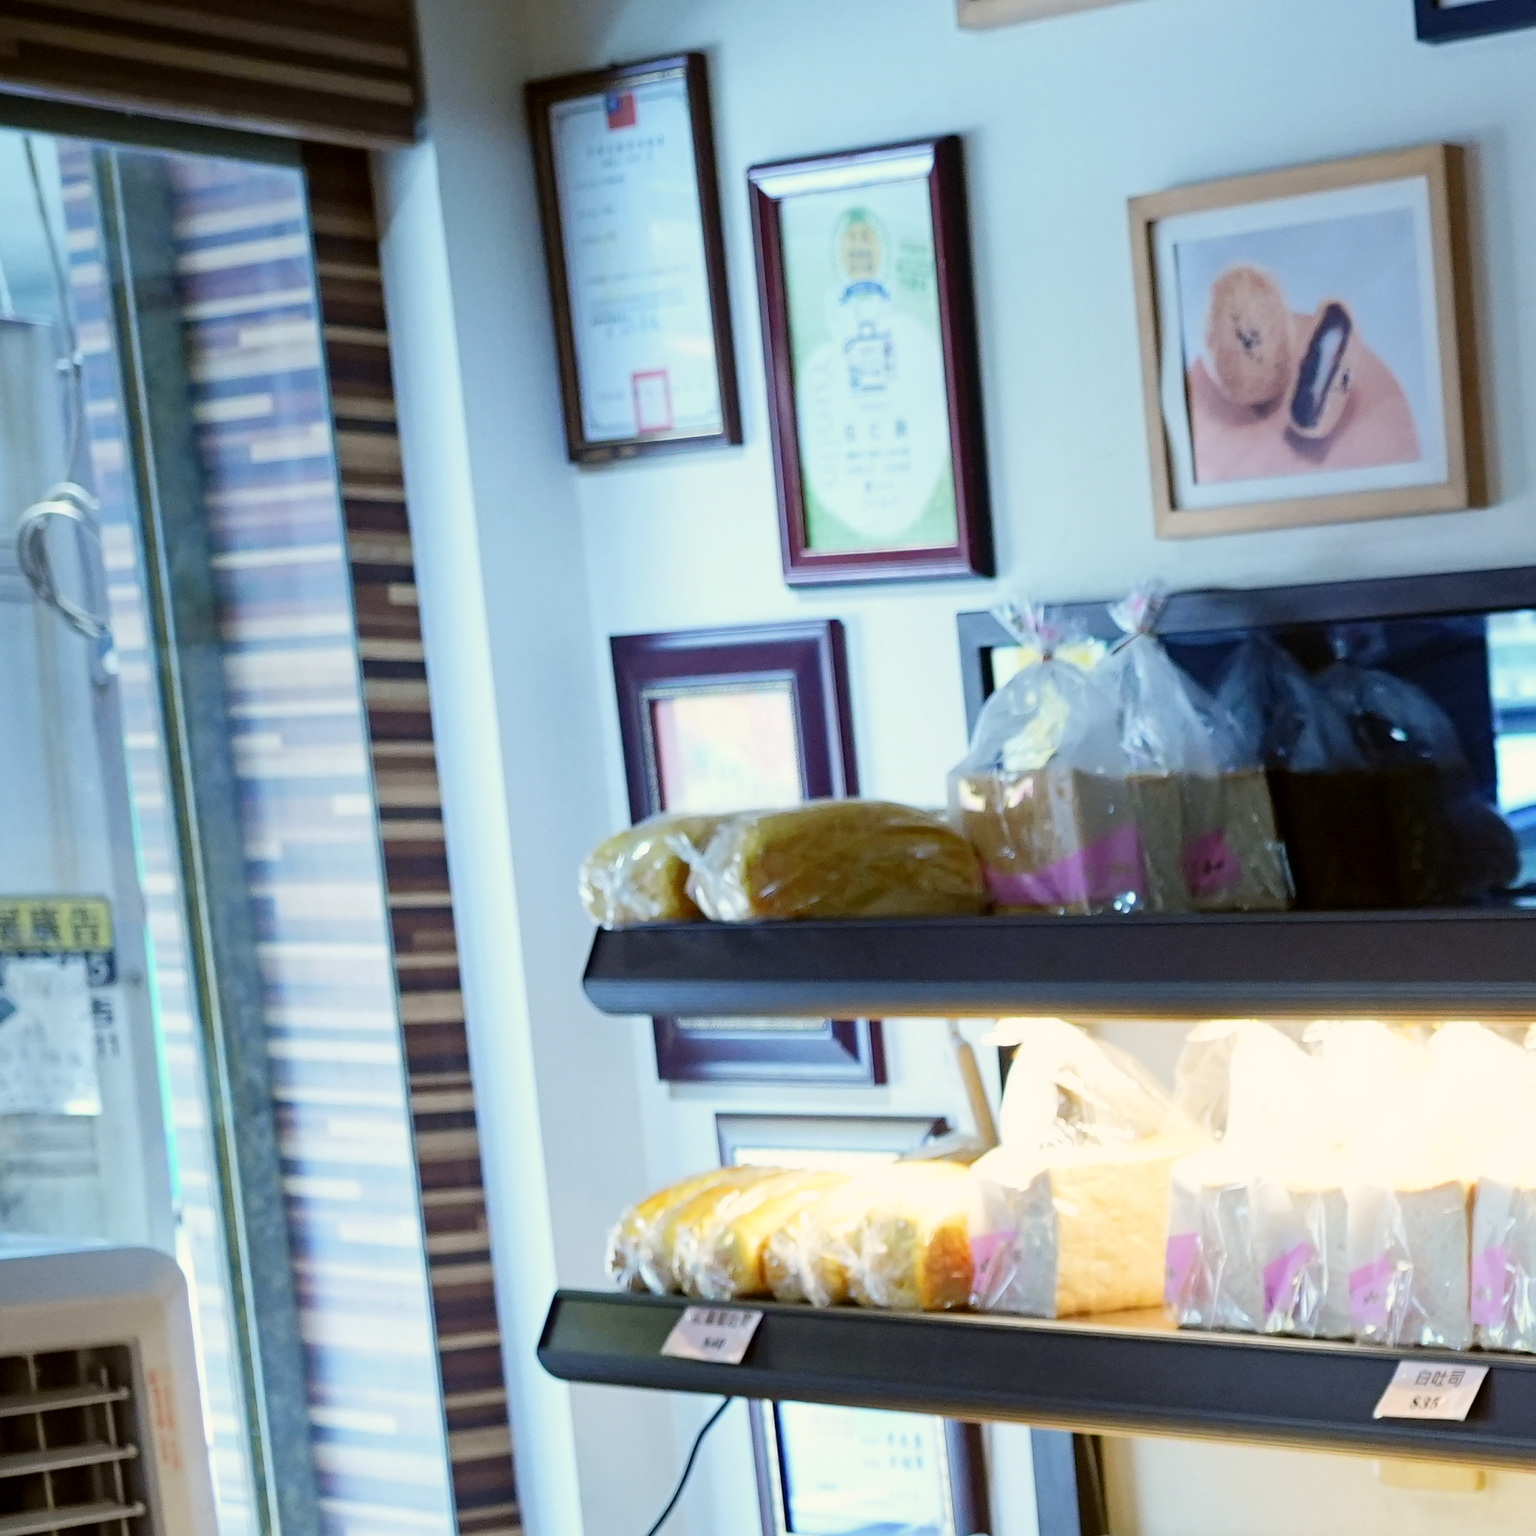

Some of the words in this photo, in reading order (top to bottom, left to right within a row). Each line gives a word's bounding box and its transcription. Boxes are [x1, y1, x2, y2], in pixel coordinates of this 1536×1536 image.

[1415, 1369, 1466, 1388] 白吐司
[1410, 1396, 1441, 1411] $35
